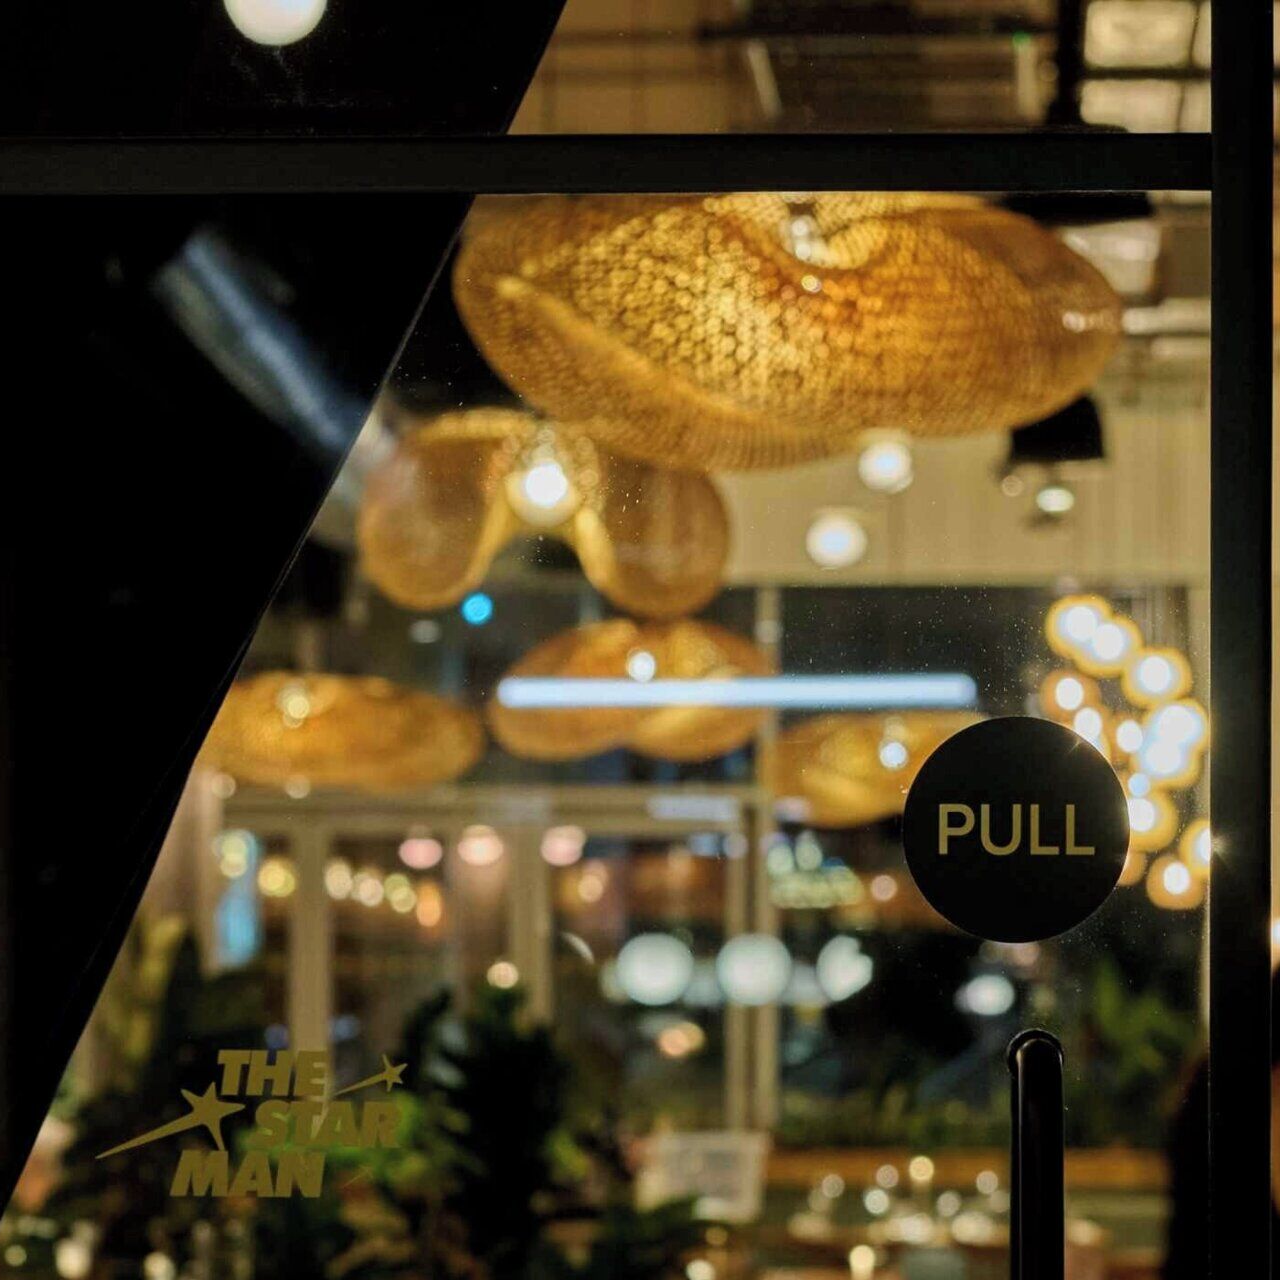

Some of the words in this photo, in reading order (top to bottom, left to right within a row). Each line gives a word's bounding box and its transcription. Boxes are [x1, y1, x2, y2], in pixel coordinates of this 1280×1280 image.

[938, 803, 1096, 856] PULL
[217, 1049, 330, 1097] THE
[253, 1100, 401, 1148] STAR
[170, 1150, 325, 1198] MAN
